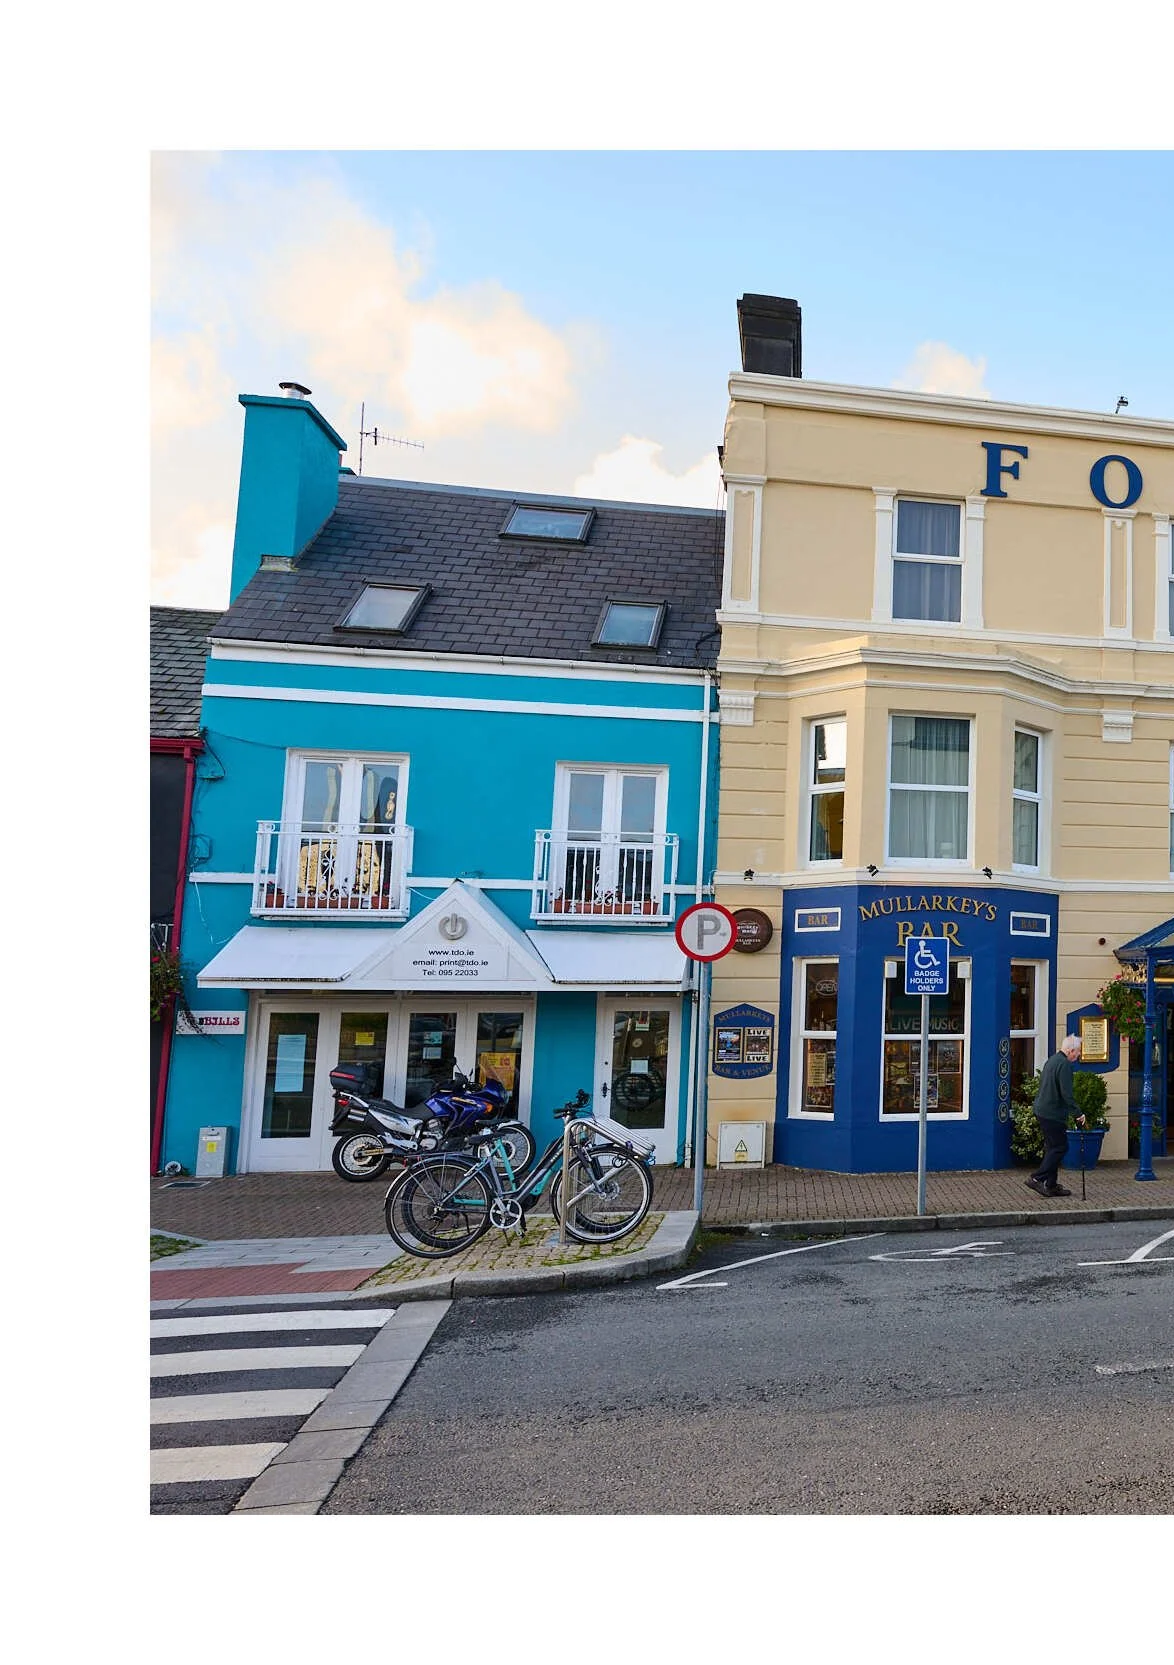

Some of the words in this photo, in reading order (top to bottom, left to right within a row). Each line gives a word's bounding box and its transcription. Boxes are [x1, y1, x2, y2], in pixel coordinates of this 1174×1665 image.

[858, 895, 998, 921] MULLARKEY'S
[807, 914, 829, 925] BAR
[896, 921, 965, 947] BAR
[439, 959, 489, 968] print@tdo.ie
[909, 977, 944, 985] HOLDERS
[890, 1017, 921, 1031] LIVE
